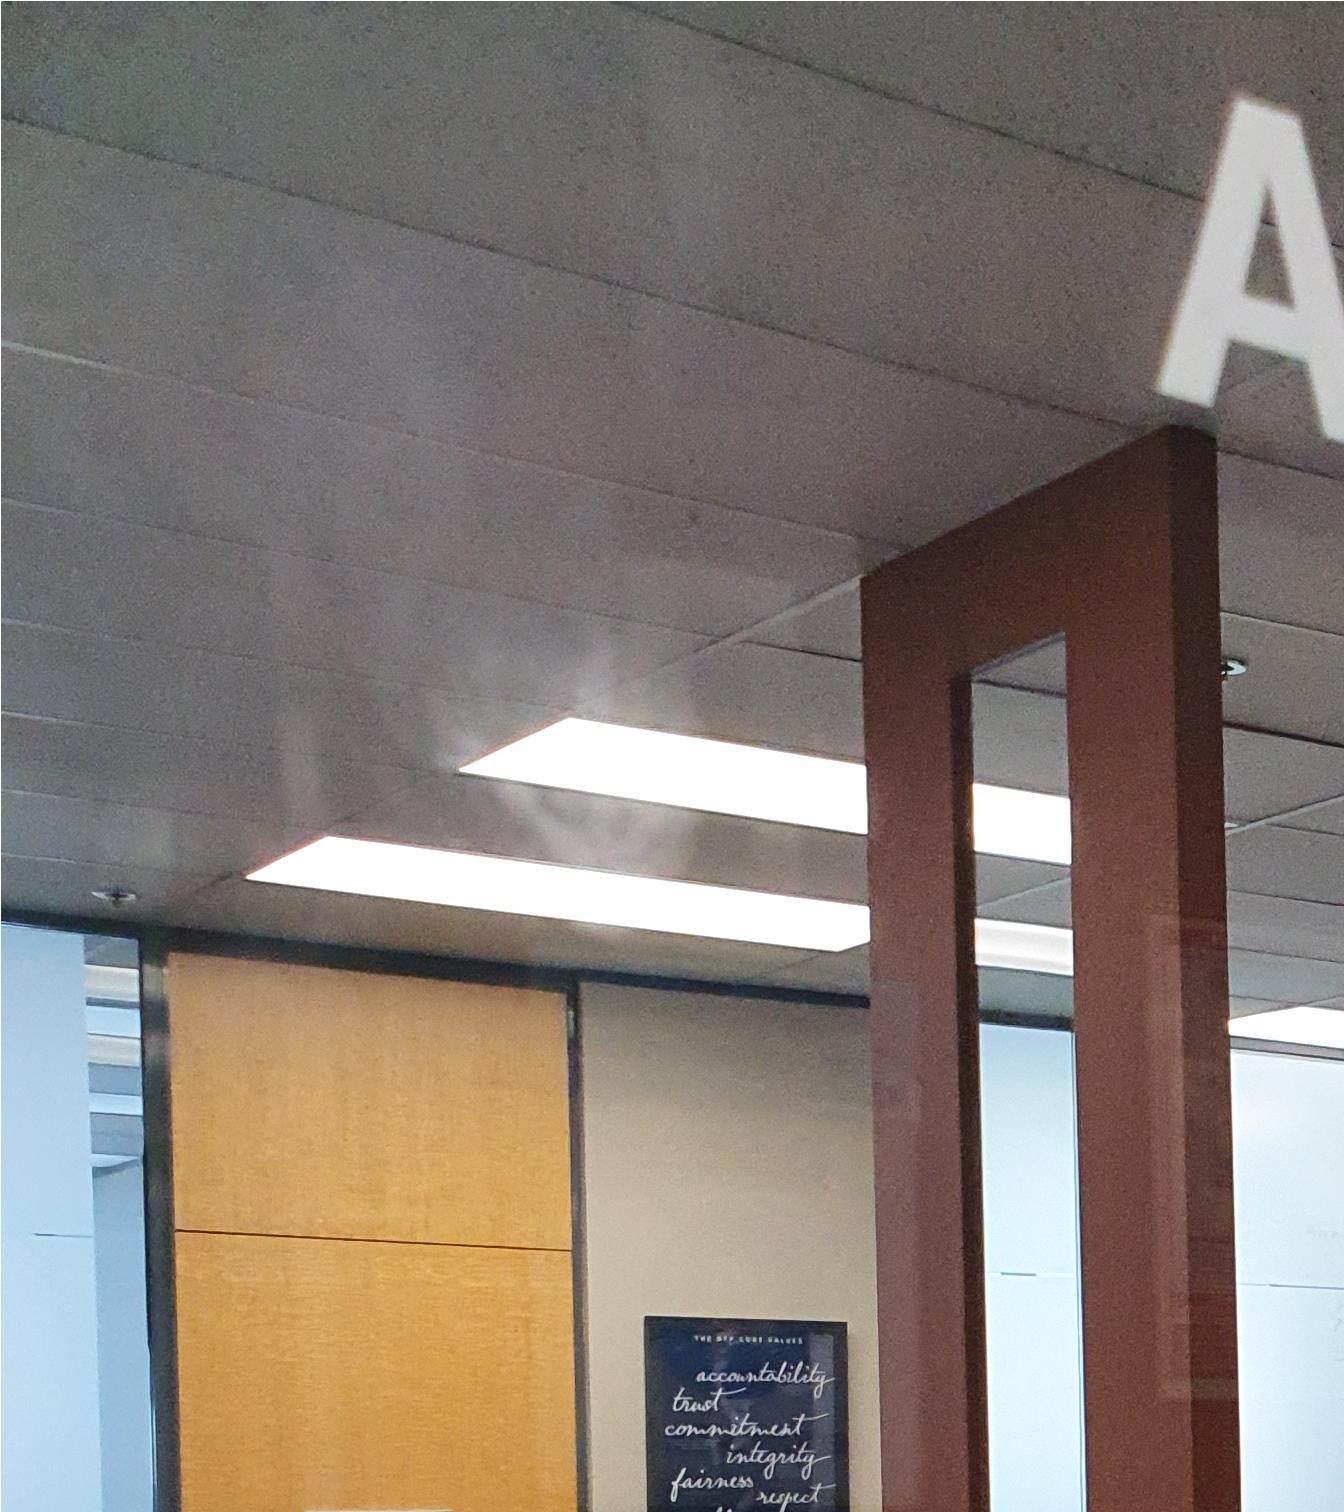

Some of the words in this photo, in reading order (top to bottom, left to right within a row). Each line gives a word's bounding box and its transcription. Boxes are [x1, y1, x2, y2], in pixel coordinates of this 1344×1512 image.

[693, 1334, 712, 1343] THE
[696, 1361, 835, 1398] accountability
[672, 1386, 747, 1412] trust
[665, 1413, 830, 1437] commitment
[726, 1441, 832, 1480] integrity
[671, 1467, 754, 1503] fairness
